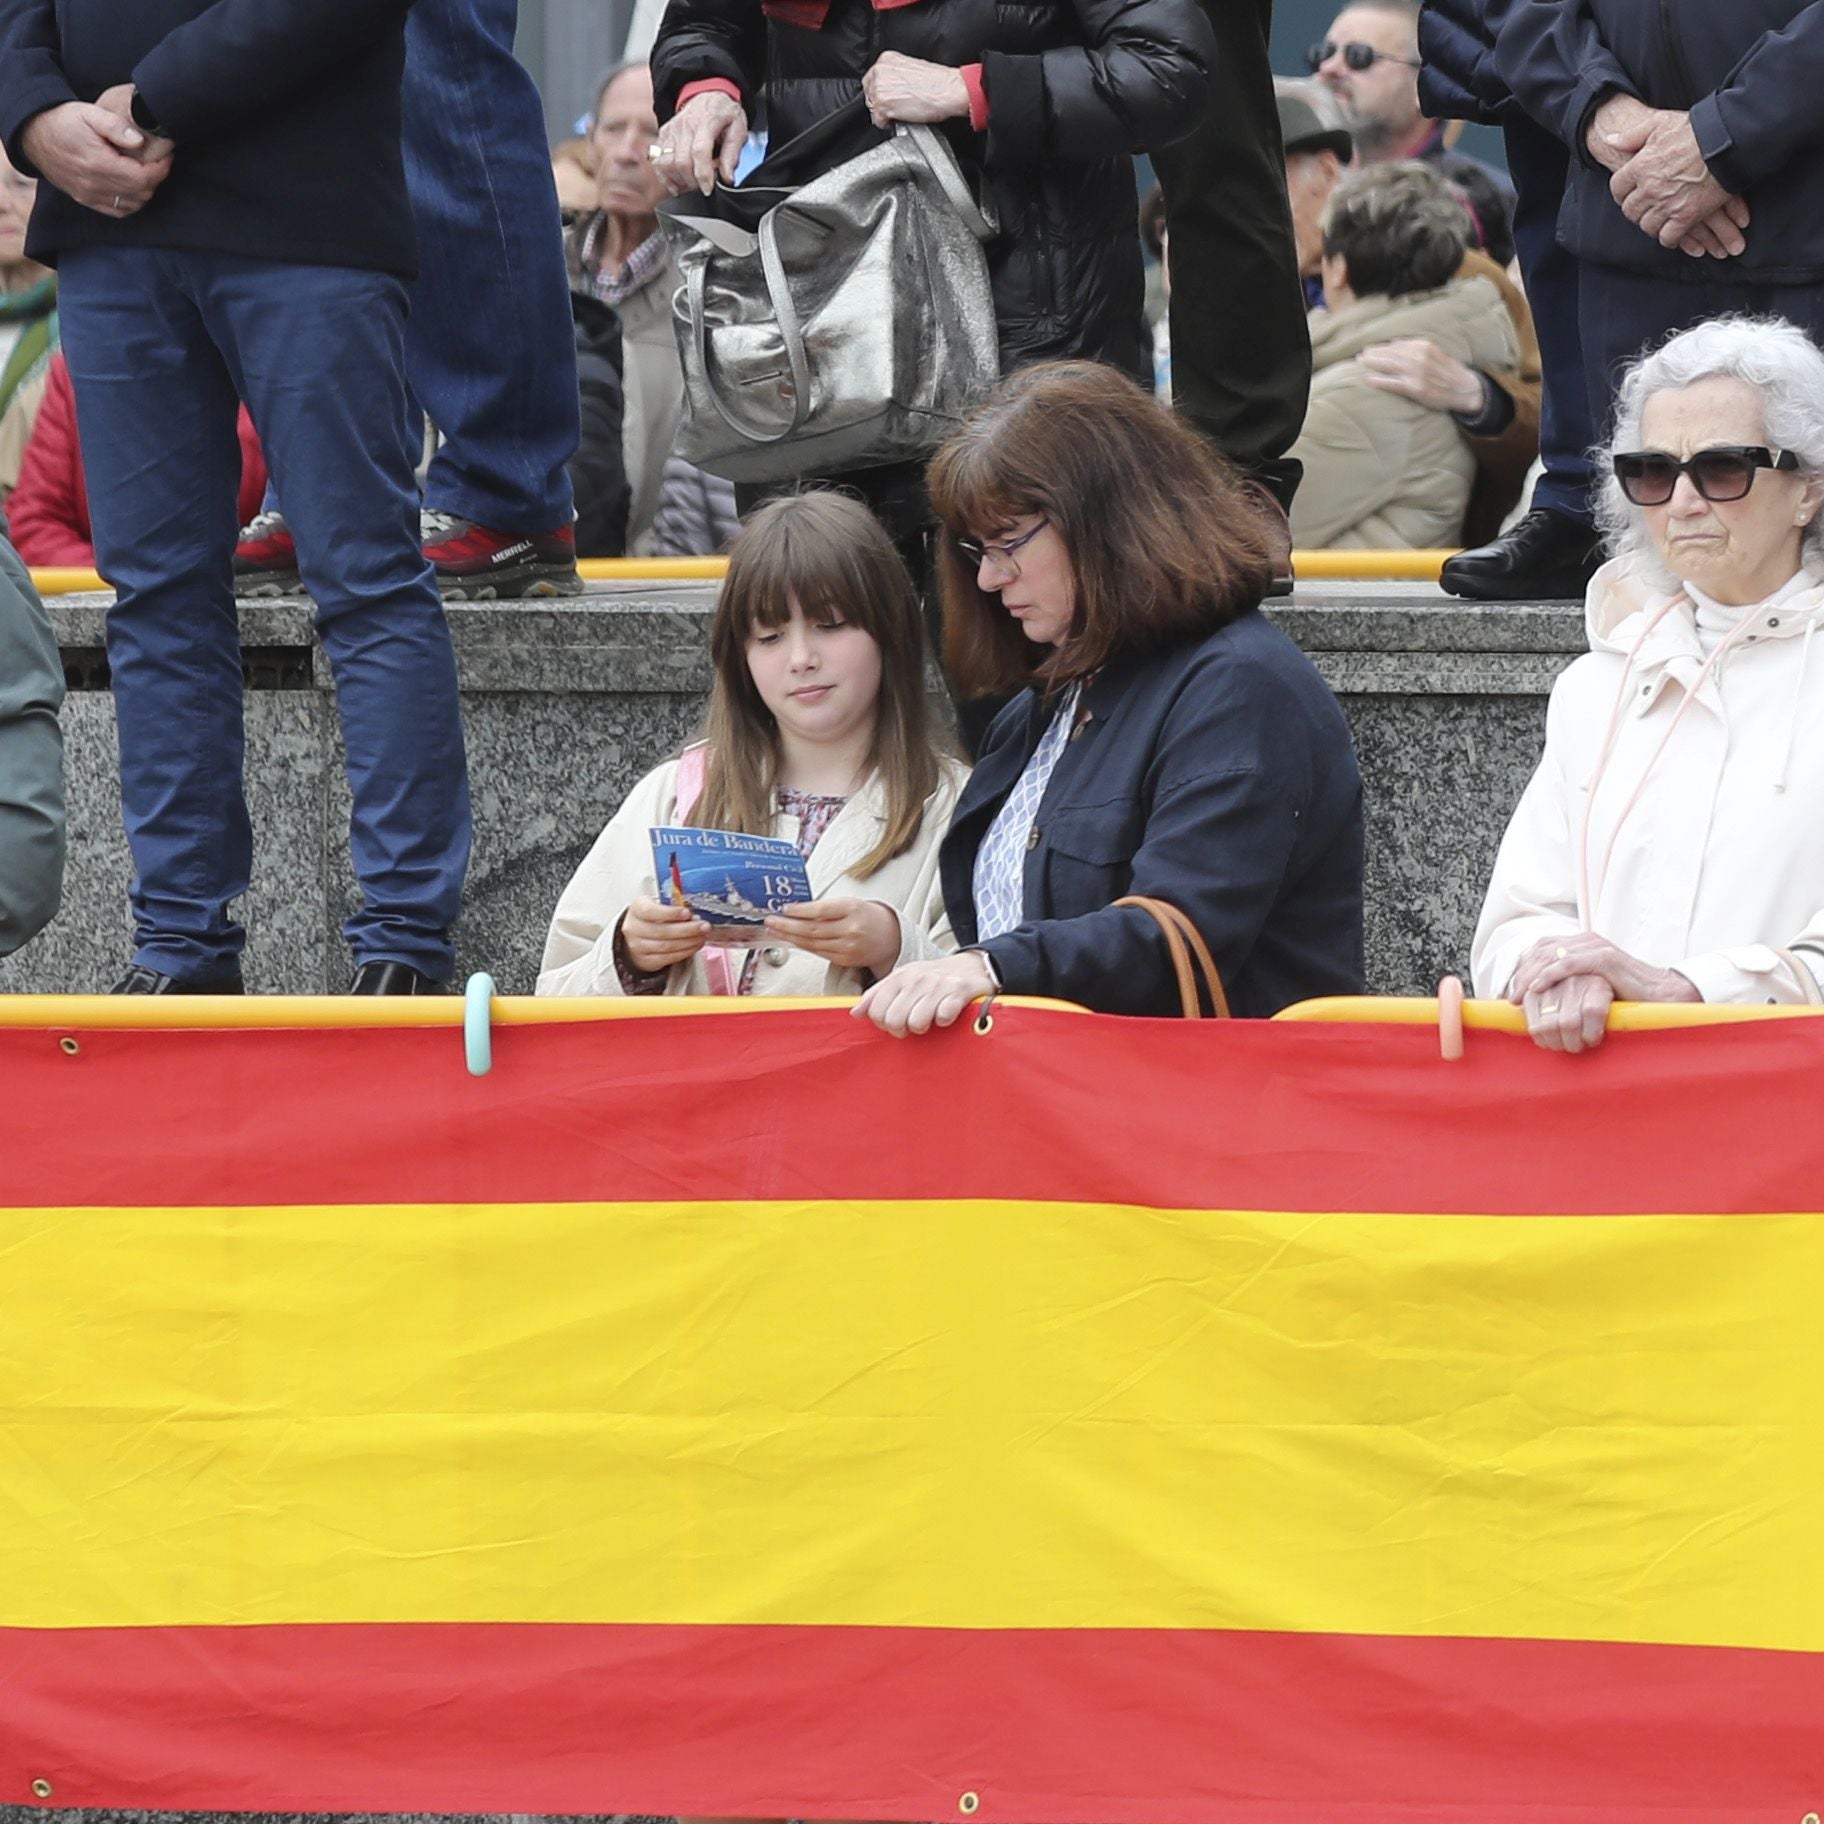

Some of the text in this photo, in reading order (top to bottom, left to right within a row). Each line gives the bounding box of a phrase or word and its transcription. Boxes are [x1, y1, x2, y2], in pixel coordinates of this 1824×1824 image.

[491, 539, 533, 564] MERRELL
[652, 829, 693, 847] Jura
[696, 832, 719, 848] de
[724, 833, 799, 856] Bandera
[764, 874, 793, 897] 18
